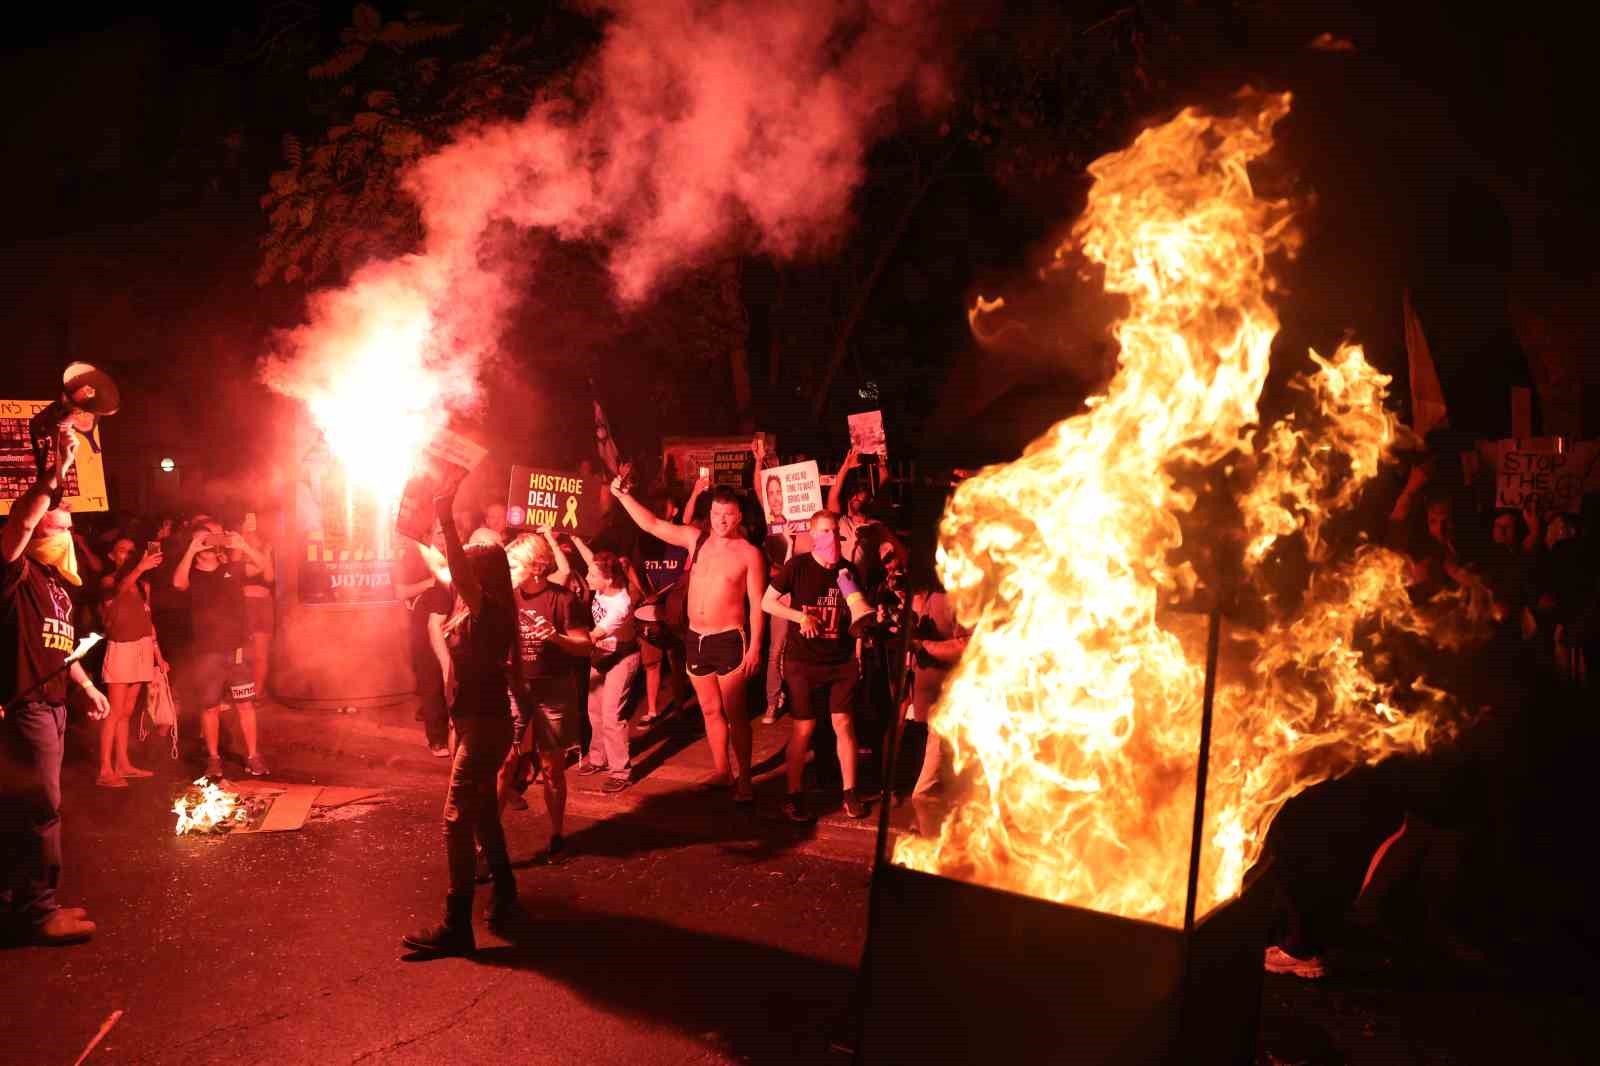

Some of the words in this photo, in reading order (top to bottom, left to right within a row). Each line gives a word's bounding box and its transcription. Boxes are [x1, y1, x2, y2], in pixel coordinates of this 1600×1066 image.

[1504, 451, 1566, 471] STOP
[529, 473, 583, 495] HOSTAGE
[1503, 472, 1550, 491] THE
[87, 496, 104, 508] די
[528, 490, 559, 508] DEAL
[526, 508, 558, 528] NOW
